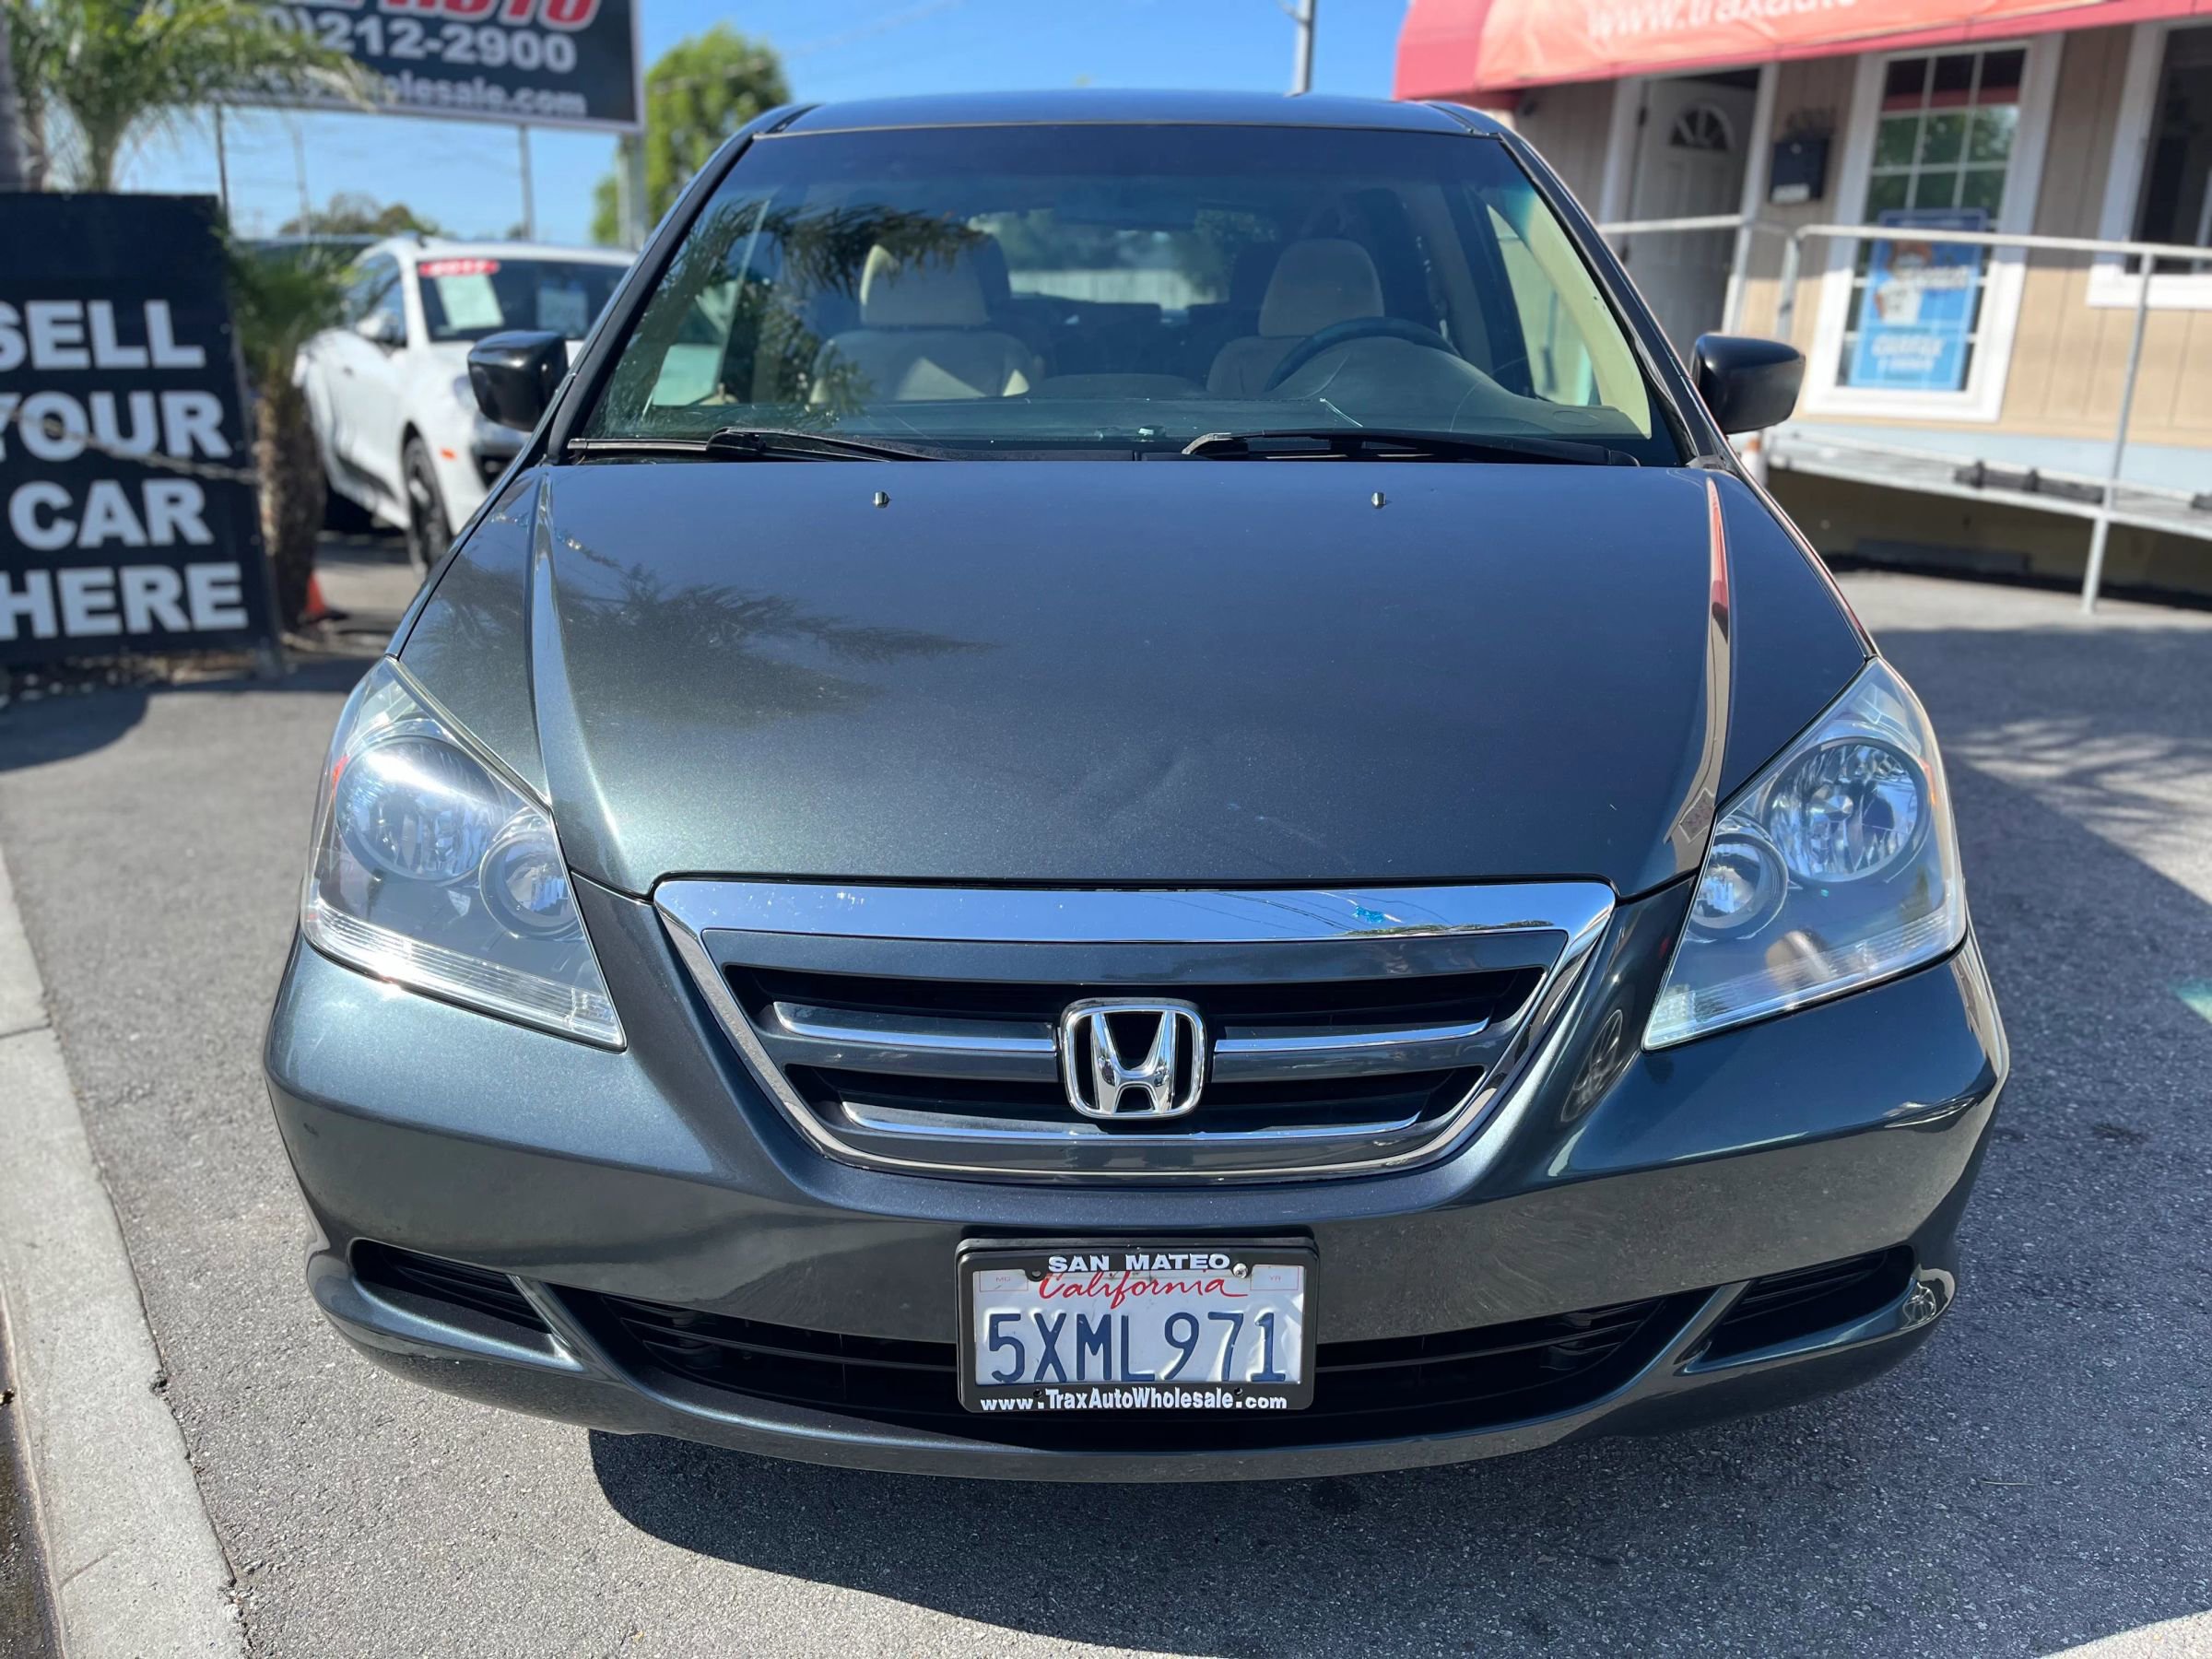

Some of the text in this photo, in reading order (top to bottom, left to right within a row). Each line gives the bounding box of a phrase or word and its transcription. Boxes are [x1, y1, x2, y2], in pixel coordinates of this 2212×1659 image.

[8, 478, 214, 550] CAR
[0, 562, 249, 640] HERE
[1039, 1269, 1249, 1310] California
[1048, 1253, 1230, 1273] SAN MATEO
[988, 1312, 1287, 1382] 5XML971
[980, 1387, 1288, 1411] www.TraxAutoWholesale.com
